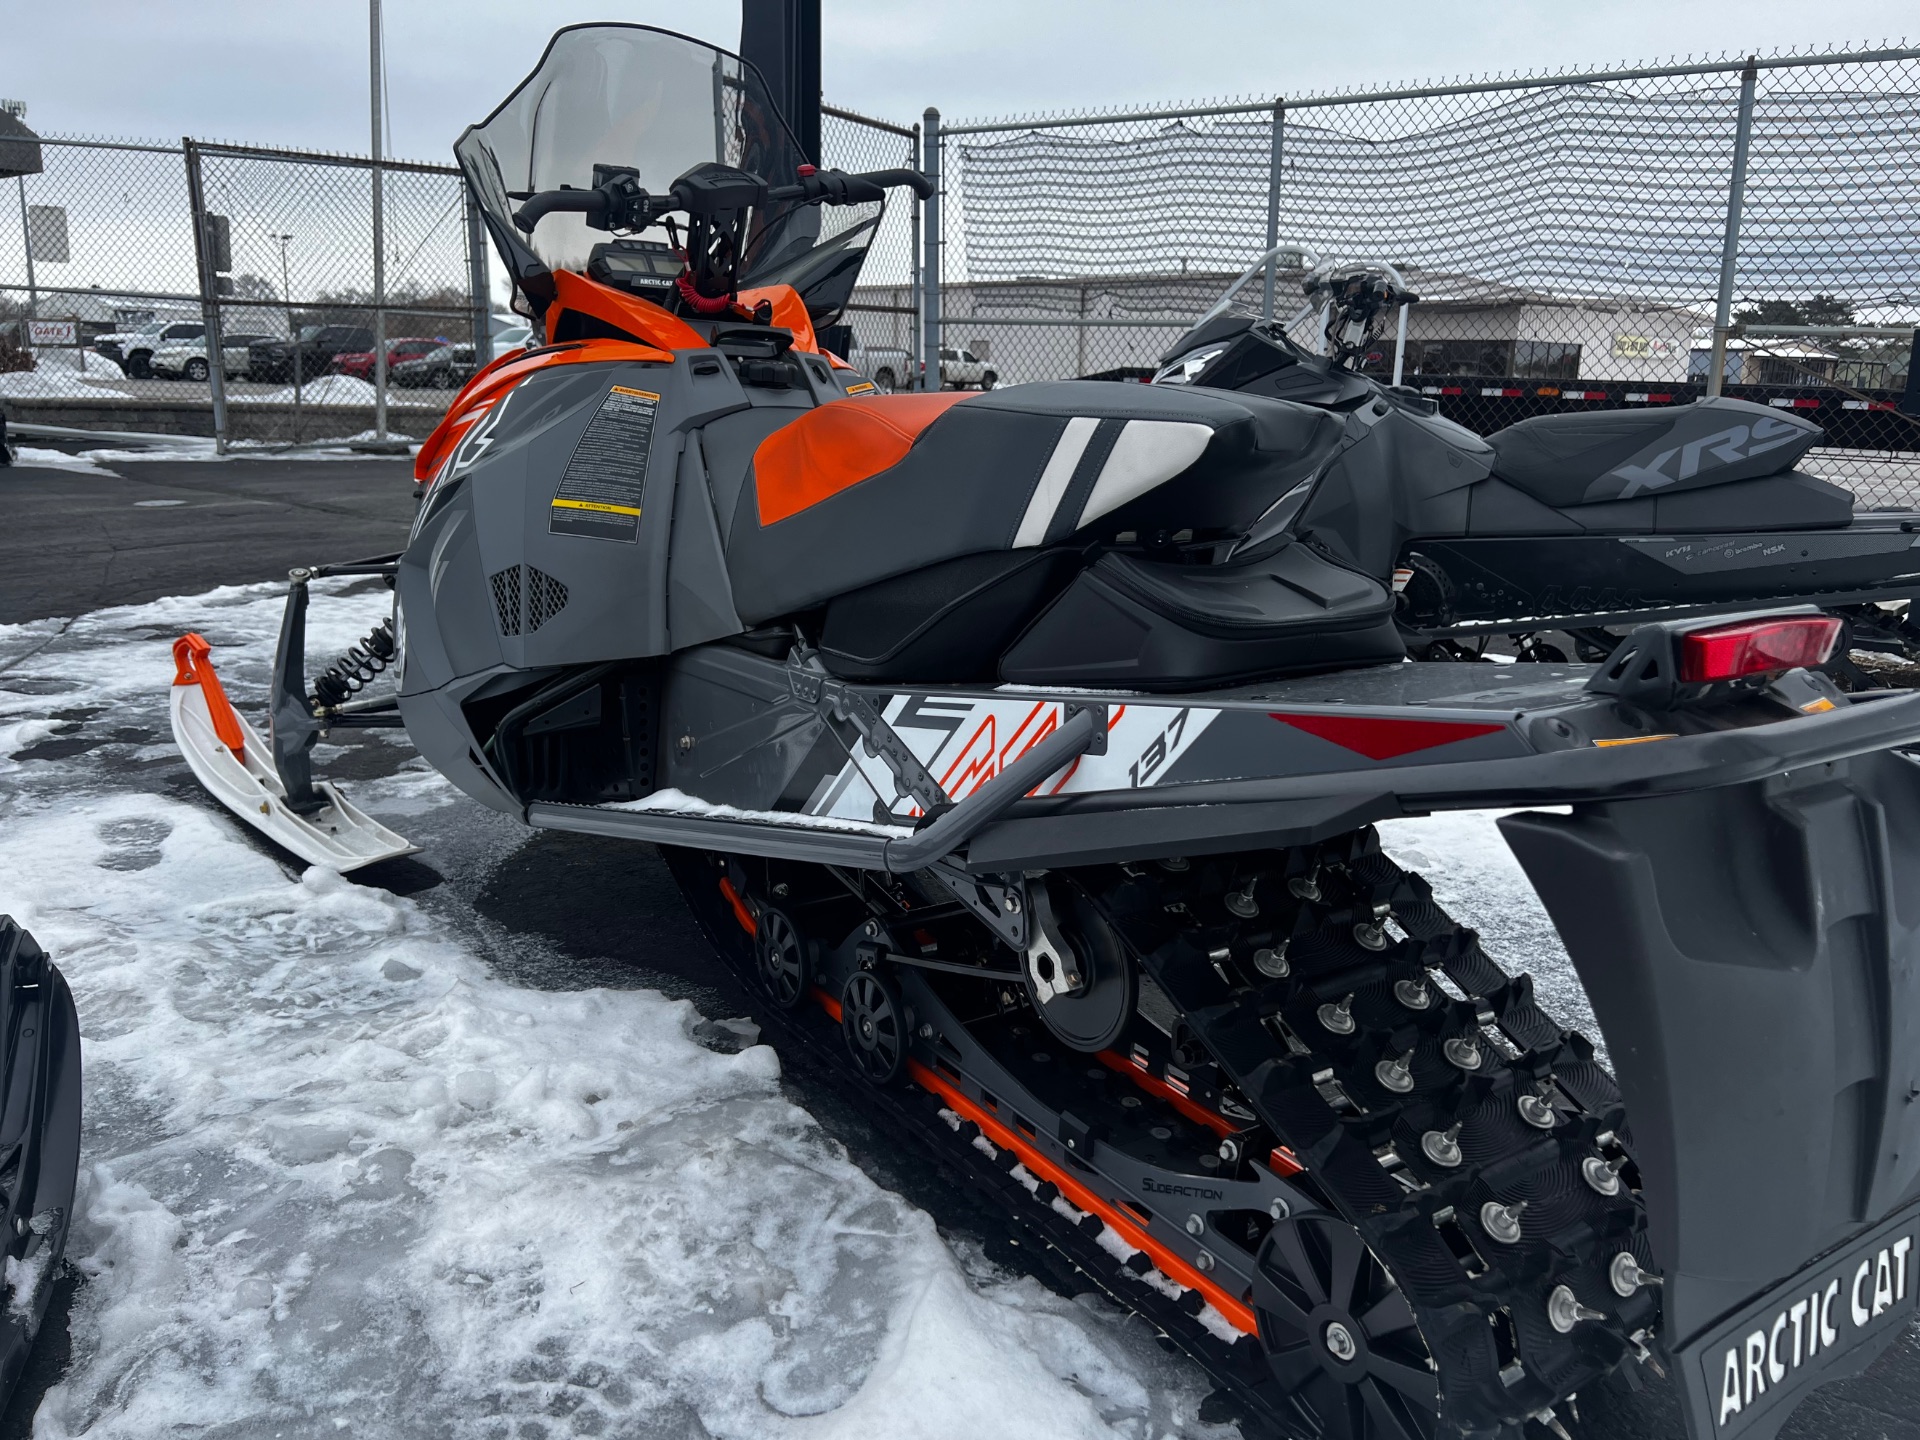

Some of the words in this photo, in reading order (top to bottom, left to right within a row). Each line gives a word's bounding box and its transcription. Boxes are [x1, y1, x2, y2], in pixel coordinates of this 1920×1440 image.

[640, 278, 661, 286] ARCTIC
[619, 388, 658, 399] AVERTISSEMENT
[1610, 416, 1809, 499] XRS
[585, 503, 612, 511] ATTENTION
[1735, 542, 1763, 555] brembo
[1762, 543, 1786, 556] NSK
[1129, 708, 1191, 788] 137
[1719, 1278, 1841, 1426] ARCTIC
[1851, 1235, 1913, 1327] CAT
